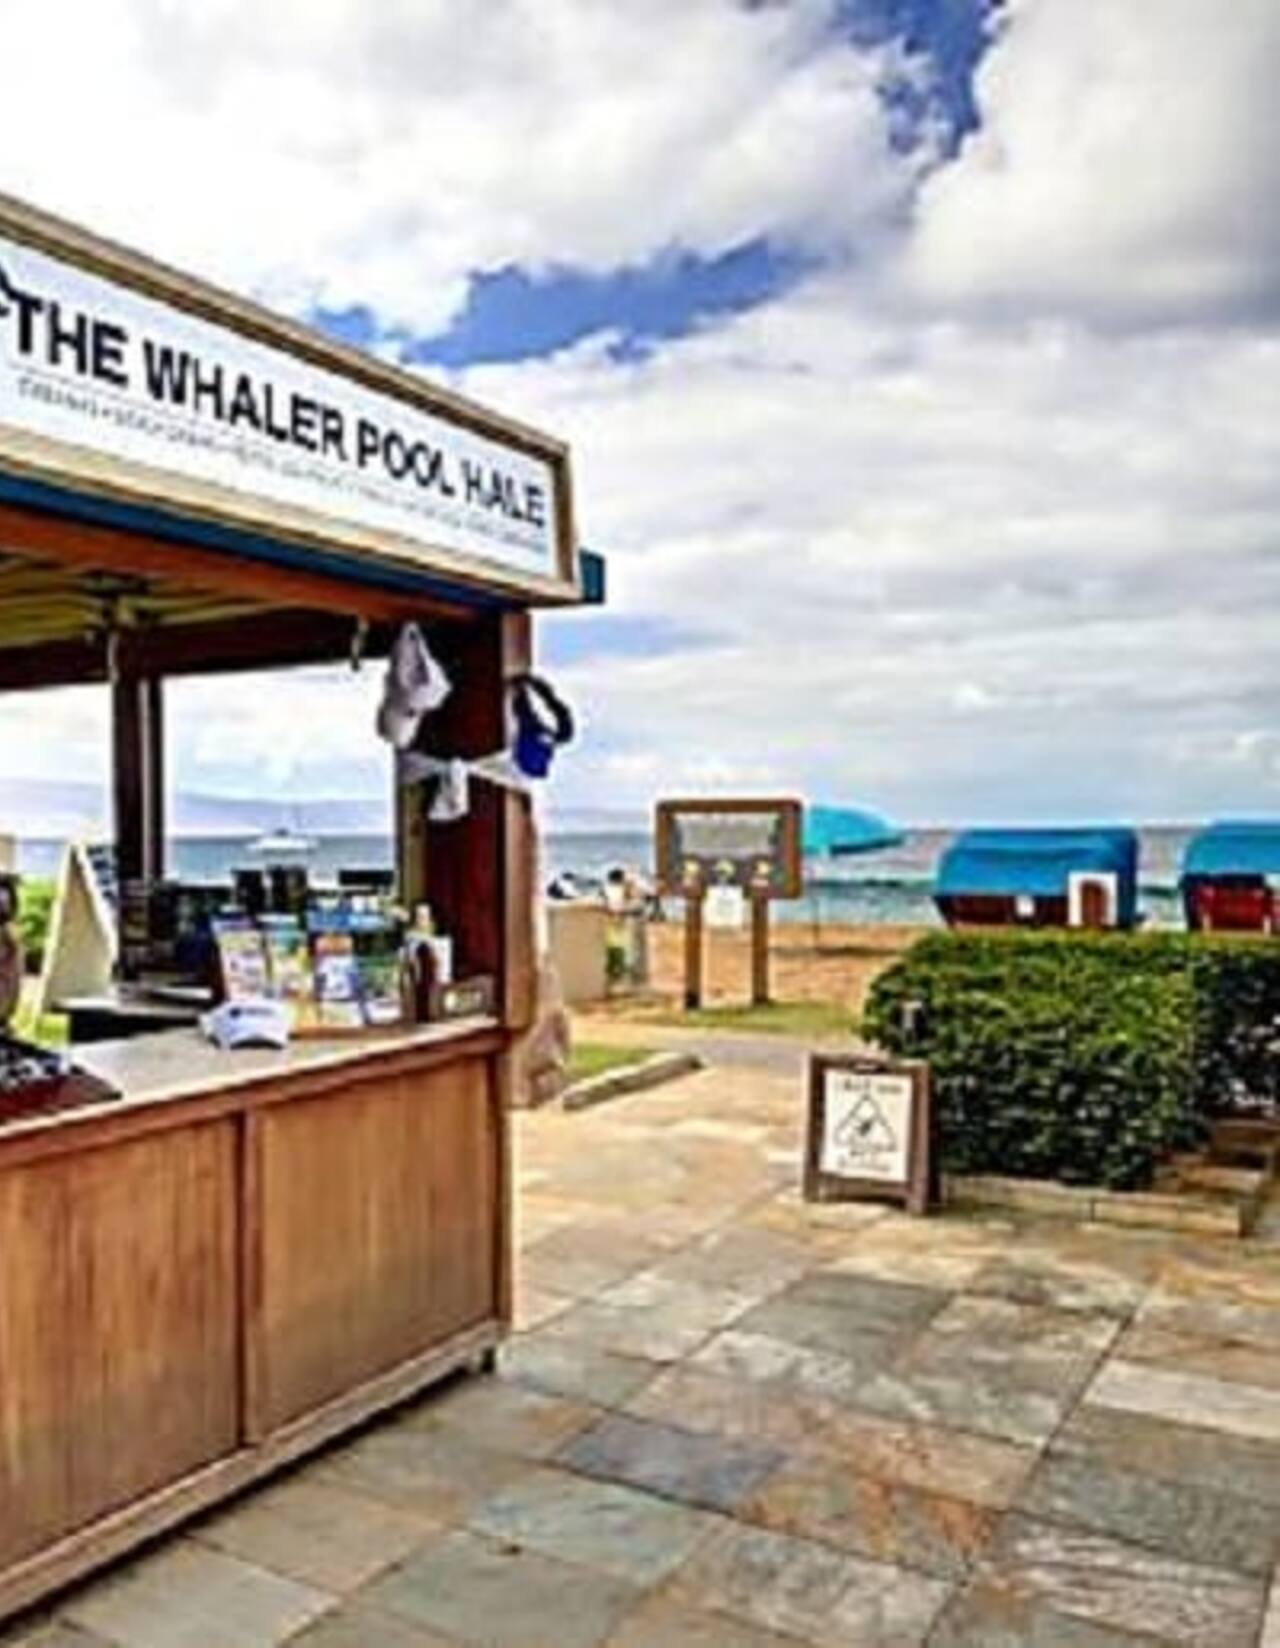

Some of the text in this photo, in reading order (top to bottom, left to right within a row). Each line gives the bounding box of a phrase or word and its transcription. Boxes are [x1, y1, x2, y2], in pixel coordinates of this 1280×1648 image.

[11, 294, 130, 386] THE
[143, 340, 348, 464] WHALER
[357, 417, 455, 497] POOL
[461, 459, 545, 528] HALE
